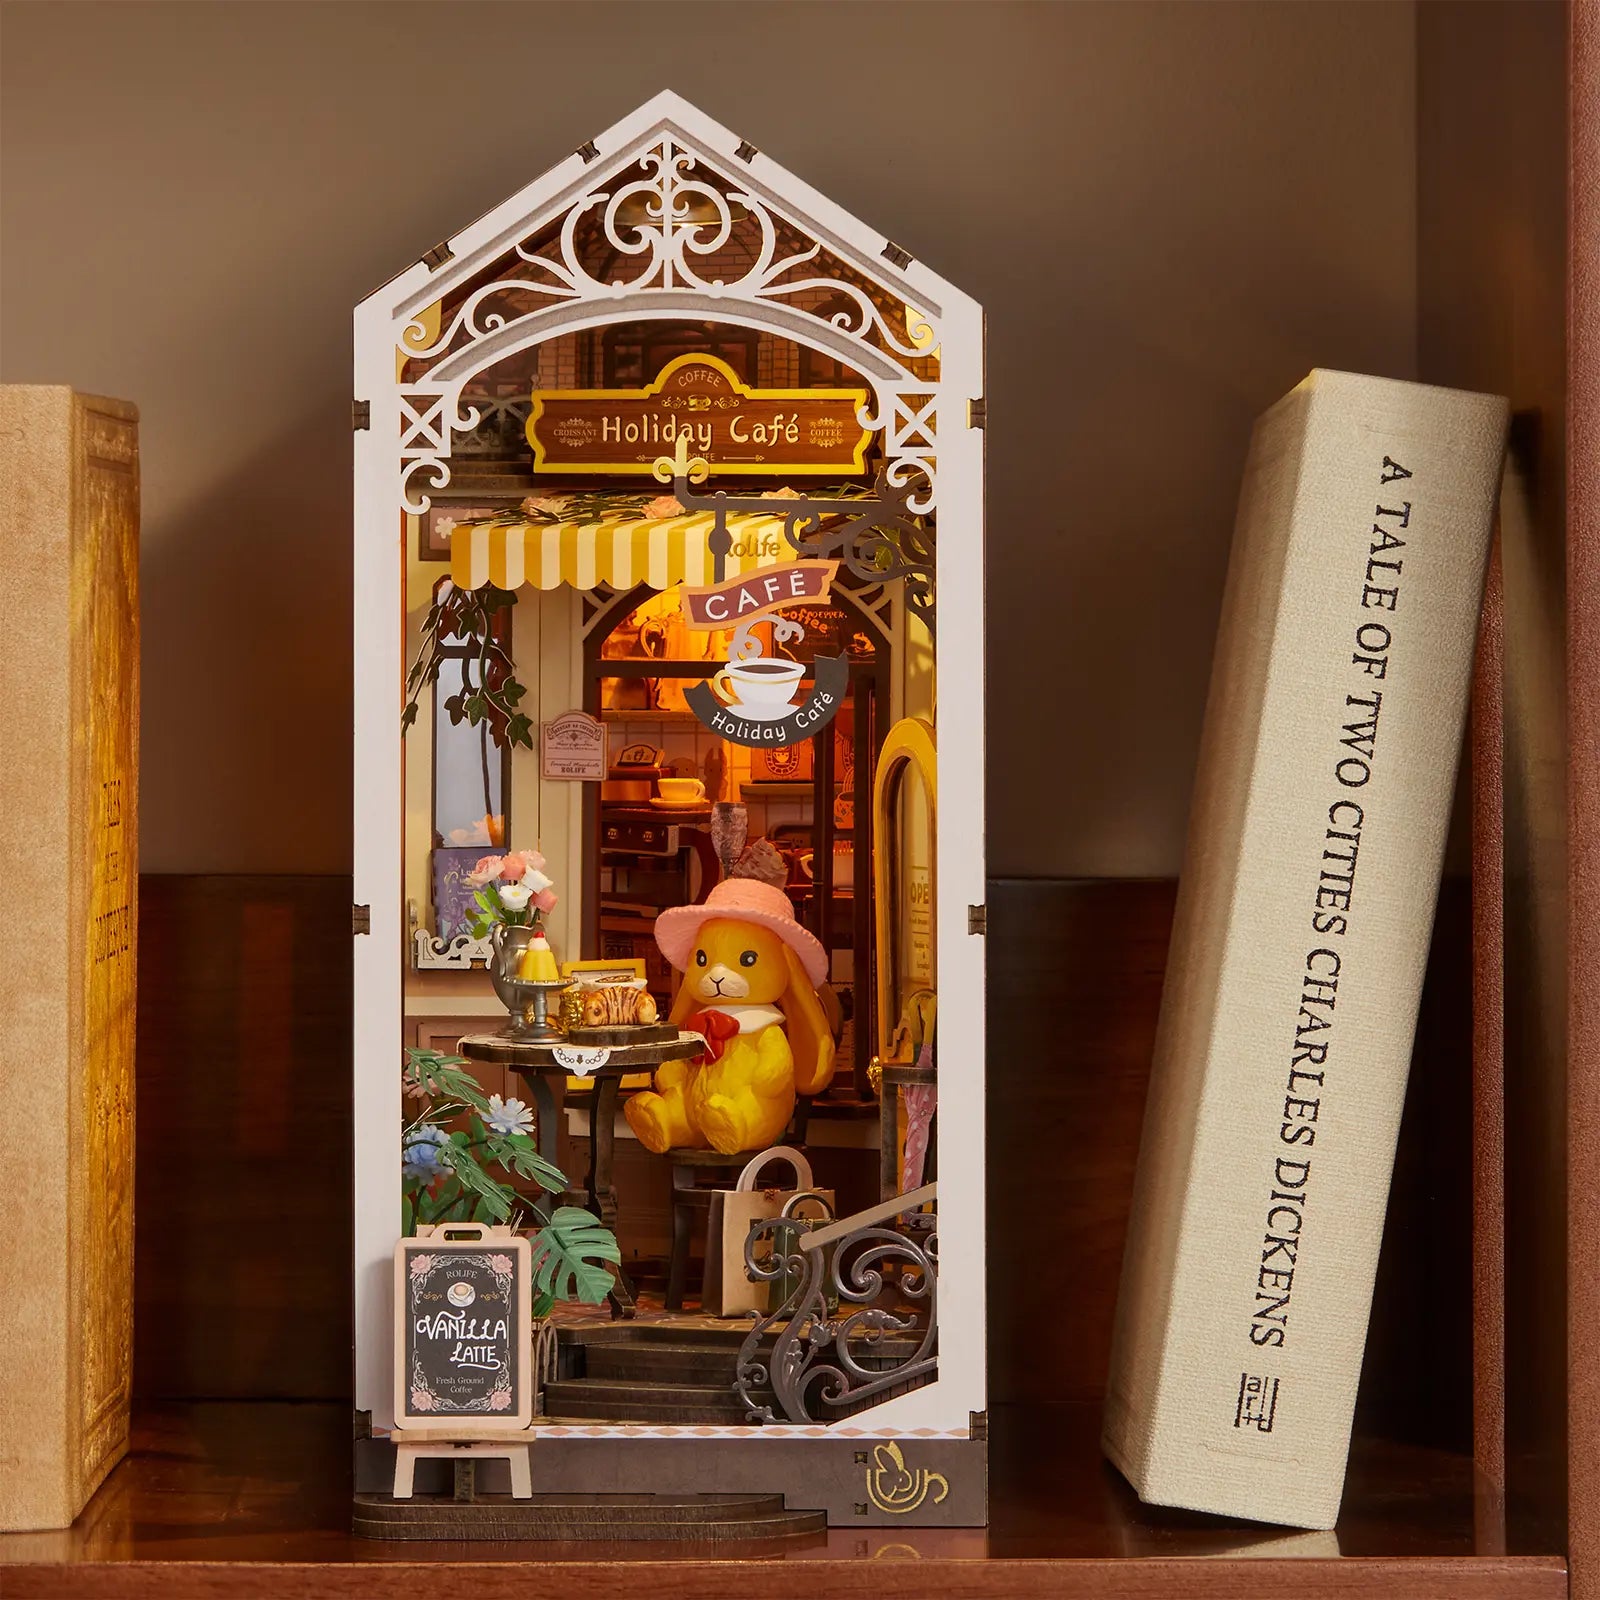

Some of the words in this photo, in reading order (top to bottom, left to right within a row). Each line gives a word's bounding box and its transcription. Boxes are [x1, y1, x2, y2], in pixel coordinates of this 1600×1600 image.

[678, 369, 722, 388] COFFEE
[553, 428, 597, 437] CROISSANT
[602, 414, 713, 451] Holiday
[729, 413, 800, 447] Café
[809, 428, 843, 437] COFFEE
[1380, 455, 1413, 485] A
[728, 533, 781, 558] olife
[1361, 501, 1412, 611] TALE
[705, 570, 805, 620] CAFÉ
[1352, 622, 1392, 680] OF
[711, 711, 787, 742] Holiday
[795, 691, 834, 728] Café
[1335, 690, 1383, 788] TWO
[1312, 799, 1365, 936] CITIES
[1280, 948, 1341, 1147] CHARLES
[1249, 1157, 1311, 1349] DICKENS
[446, 1269, 478, 1279] ROLIFE
[416, 1310, 507, 1340] VANILLA
[449, 1341, 501, 1370] LATTE
[450, 1386, 473, 1394] Coffee
